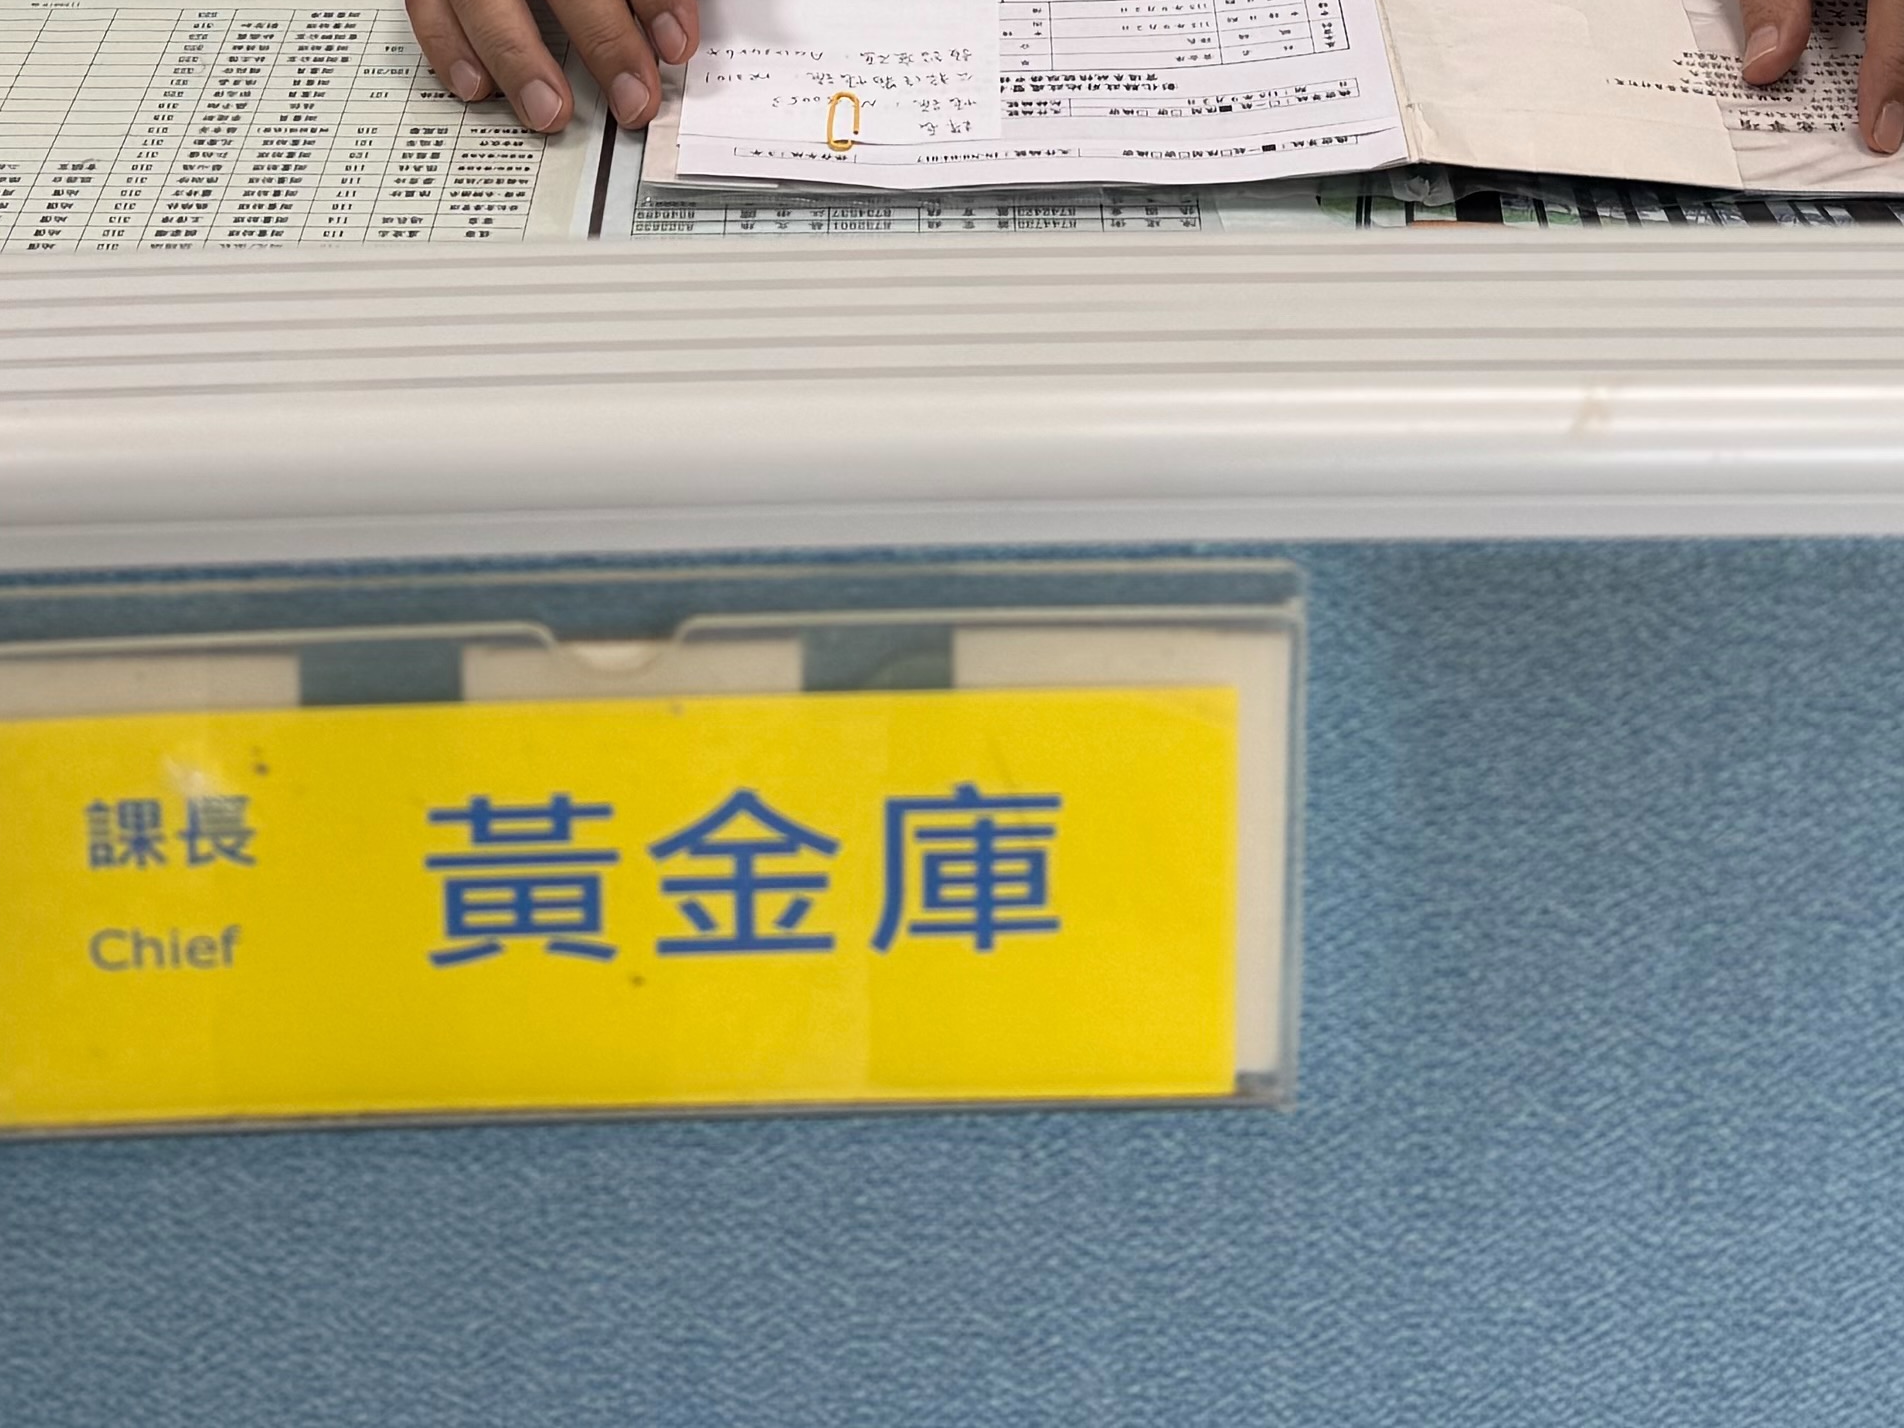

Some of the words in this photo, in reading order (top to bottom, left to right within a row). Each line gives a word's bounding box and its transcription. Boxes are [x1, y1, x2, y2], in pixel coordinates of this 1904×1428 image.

[86, 797, 260, 870] 課長
[424, 784, 1064, 968] 黃金庫
[88, 927, 240, 973] Chief
